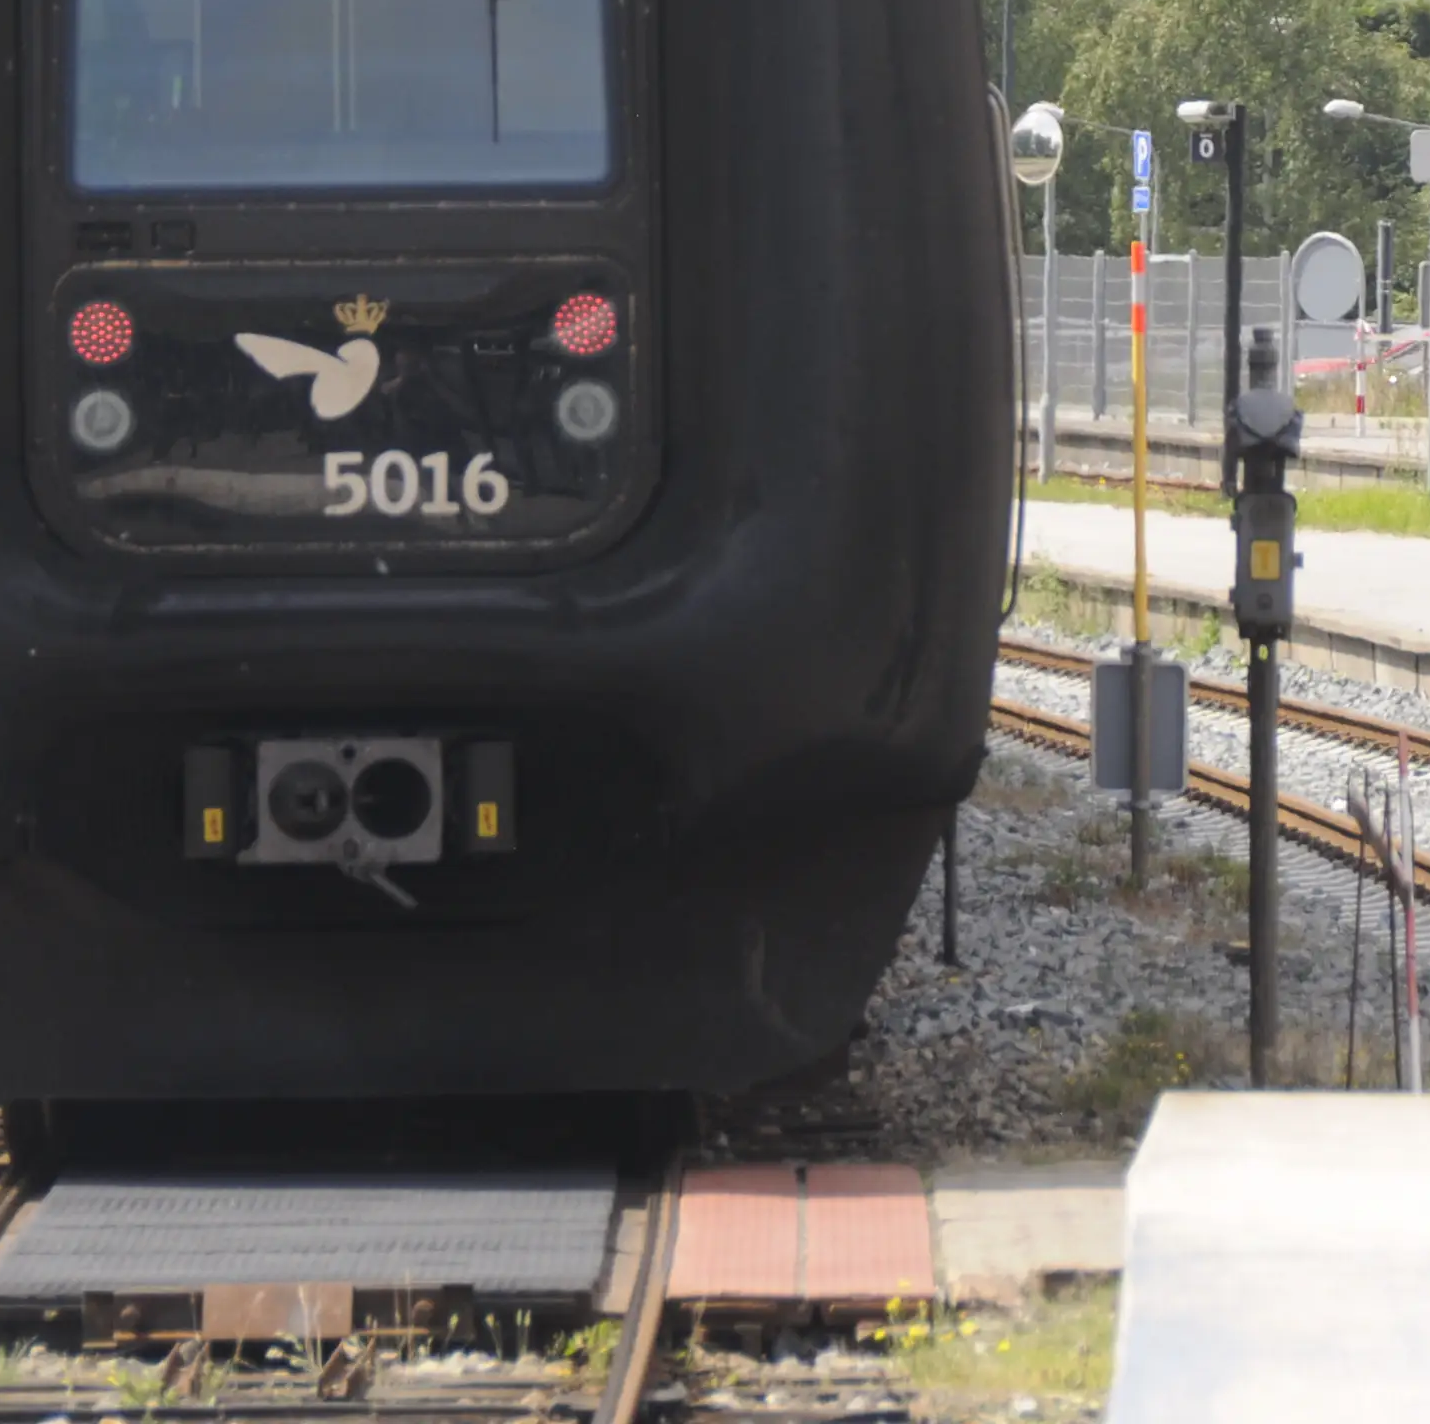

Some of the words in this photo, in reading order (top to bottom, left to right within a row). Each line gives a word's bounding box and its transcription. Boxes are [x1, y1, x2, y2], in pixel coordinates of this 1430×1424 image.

[1137, 137, 1148, 175] P
[1199, 138, 1214, 158] 0
[324, 449, 509, 516] 5016
